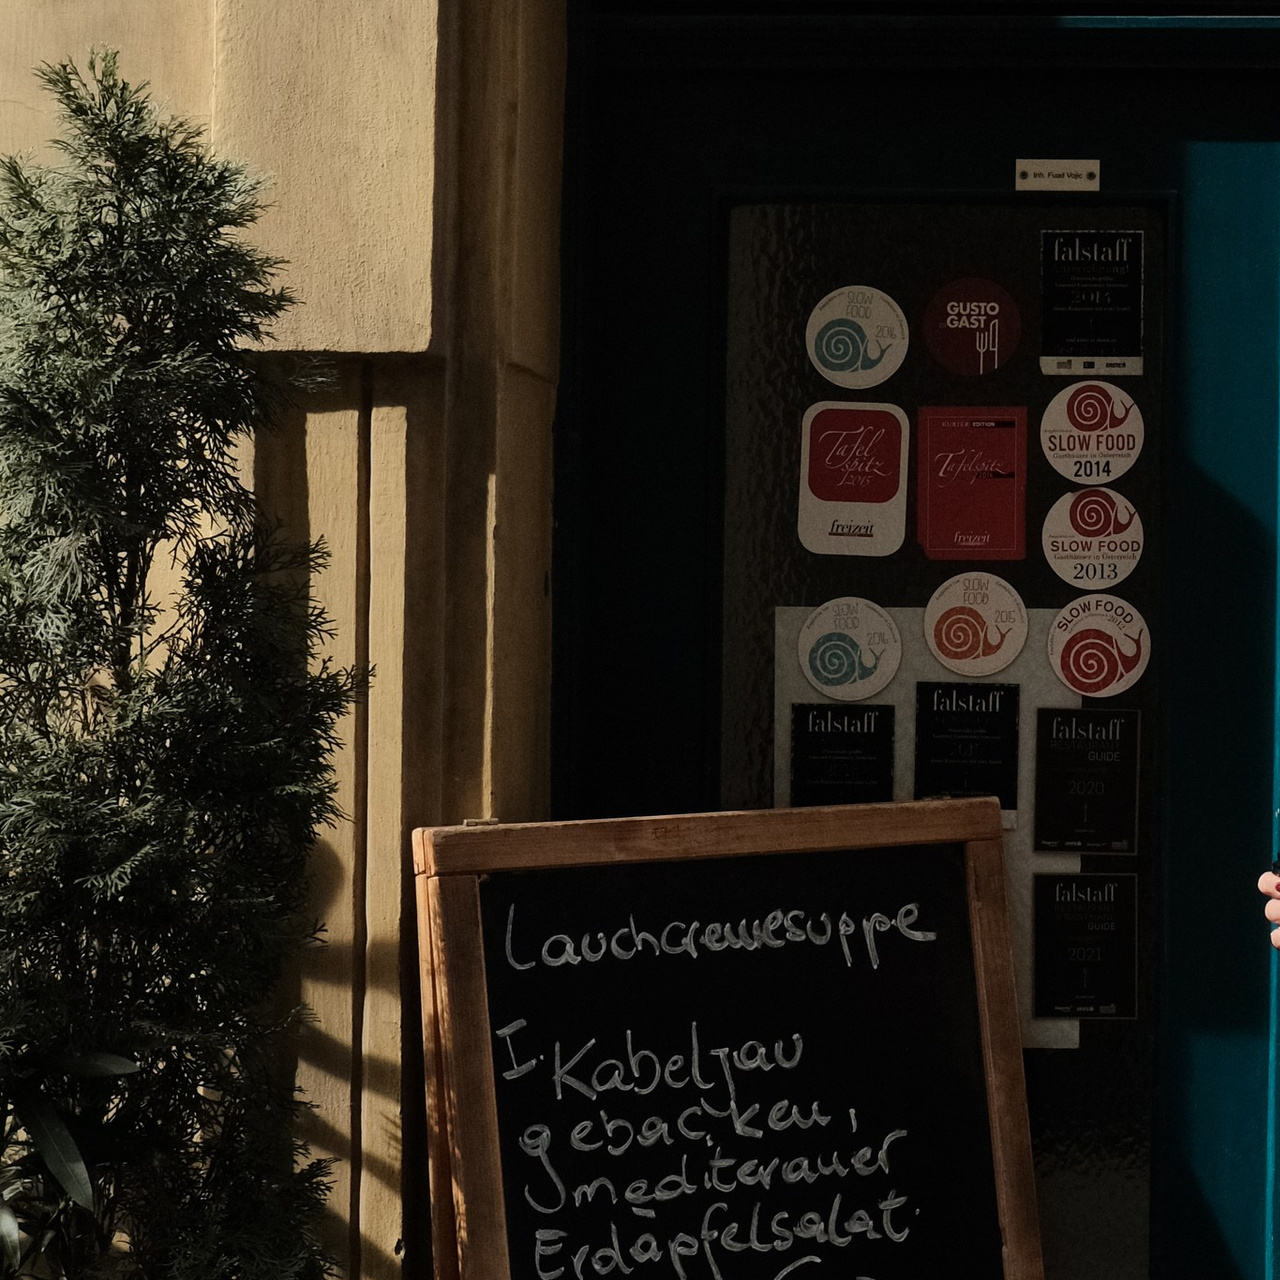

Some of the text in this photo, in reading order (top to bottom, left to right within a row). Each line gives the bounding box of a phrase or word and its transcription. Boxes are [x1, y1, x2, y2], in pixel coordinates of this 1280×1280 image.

[1047, 171, 1065, 179] Fuad
[1053, 237, 1132, 262] falstaff
[847, 290, 874, 305] SLOW
[846, 305, 872, 319] FOOD
[946, 301, 1000, 315] GUSTO
[946, 315, 987, 328] GAST
[818, 425, 886, 470] Tafel
[1048, 433, 1136, 451] SLOW FOOD
[836, 456, 893, 487] spitz
[934, 448, 1007, 488] Tafelspitz
[1073, 460, 1112, 477] 2014
[829, 519, 874, 535] freizeit
[953, 530, 991, 544] freizeit
[1050, 540, 1141, 552] SLOW FOOD
[1073, 562, 1118, 580] 2013
[963, 578, 990, 592] SLOW
[963, 592, 989, 605] FOOD
[832, 602, 859, 617] SLOW
[1057, 600, 1091, 632] SLOW
[1095, 599, 1134, 624] FOOD
[833, 616, 860, 630] FOOD
[932, 688, 1004, 713] falstaff
[807, 710, 879, 733] falstaff
[1052, 716, 1125, 741] falstaff
[1087, 751, 1121, 762] GUIDE
[1068, 781, 1105, 796] 2020
[1055, 882, 1119, 903] falstaff
[1087, 922, 1117, 931] GUIDE
[1068, 947, 1104, 962] 2021
[552, 1020, 803, 1118] Kabeljau
